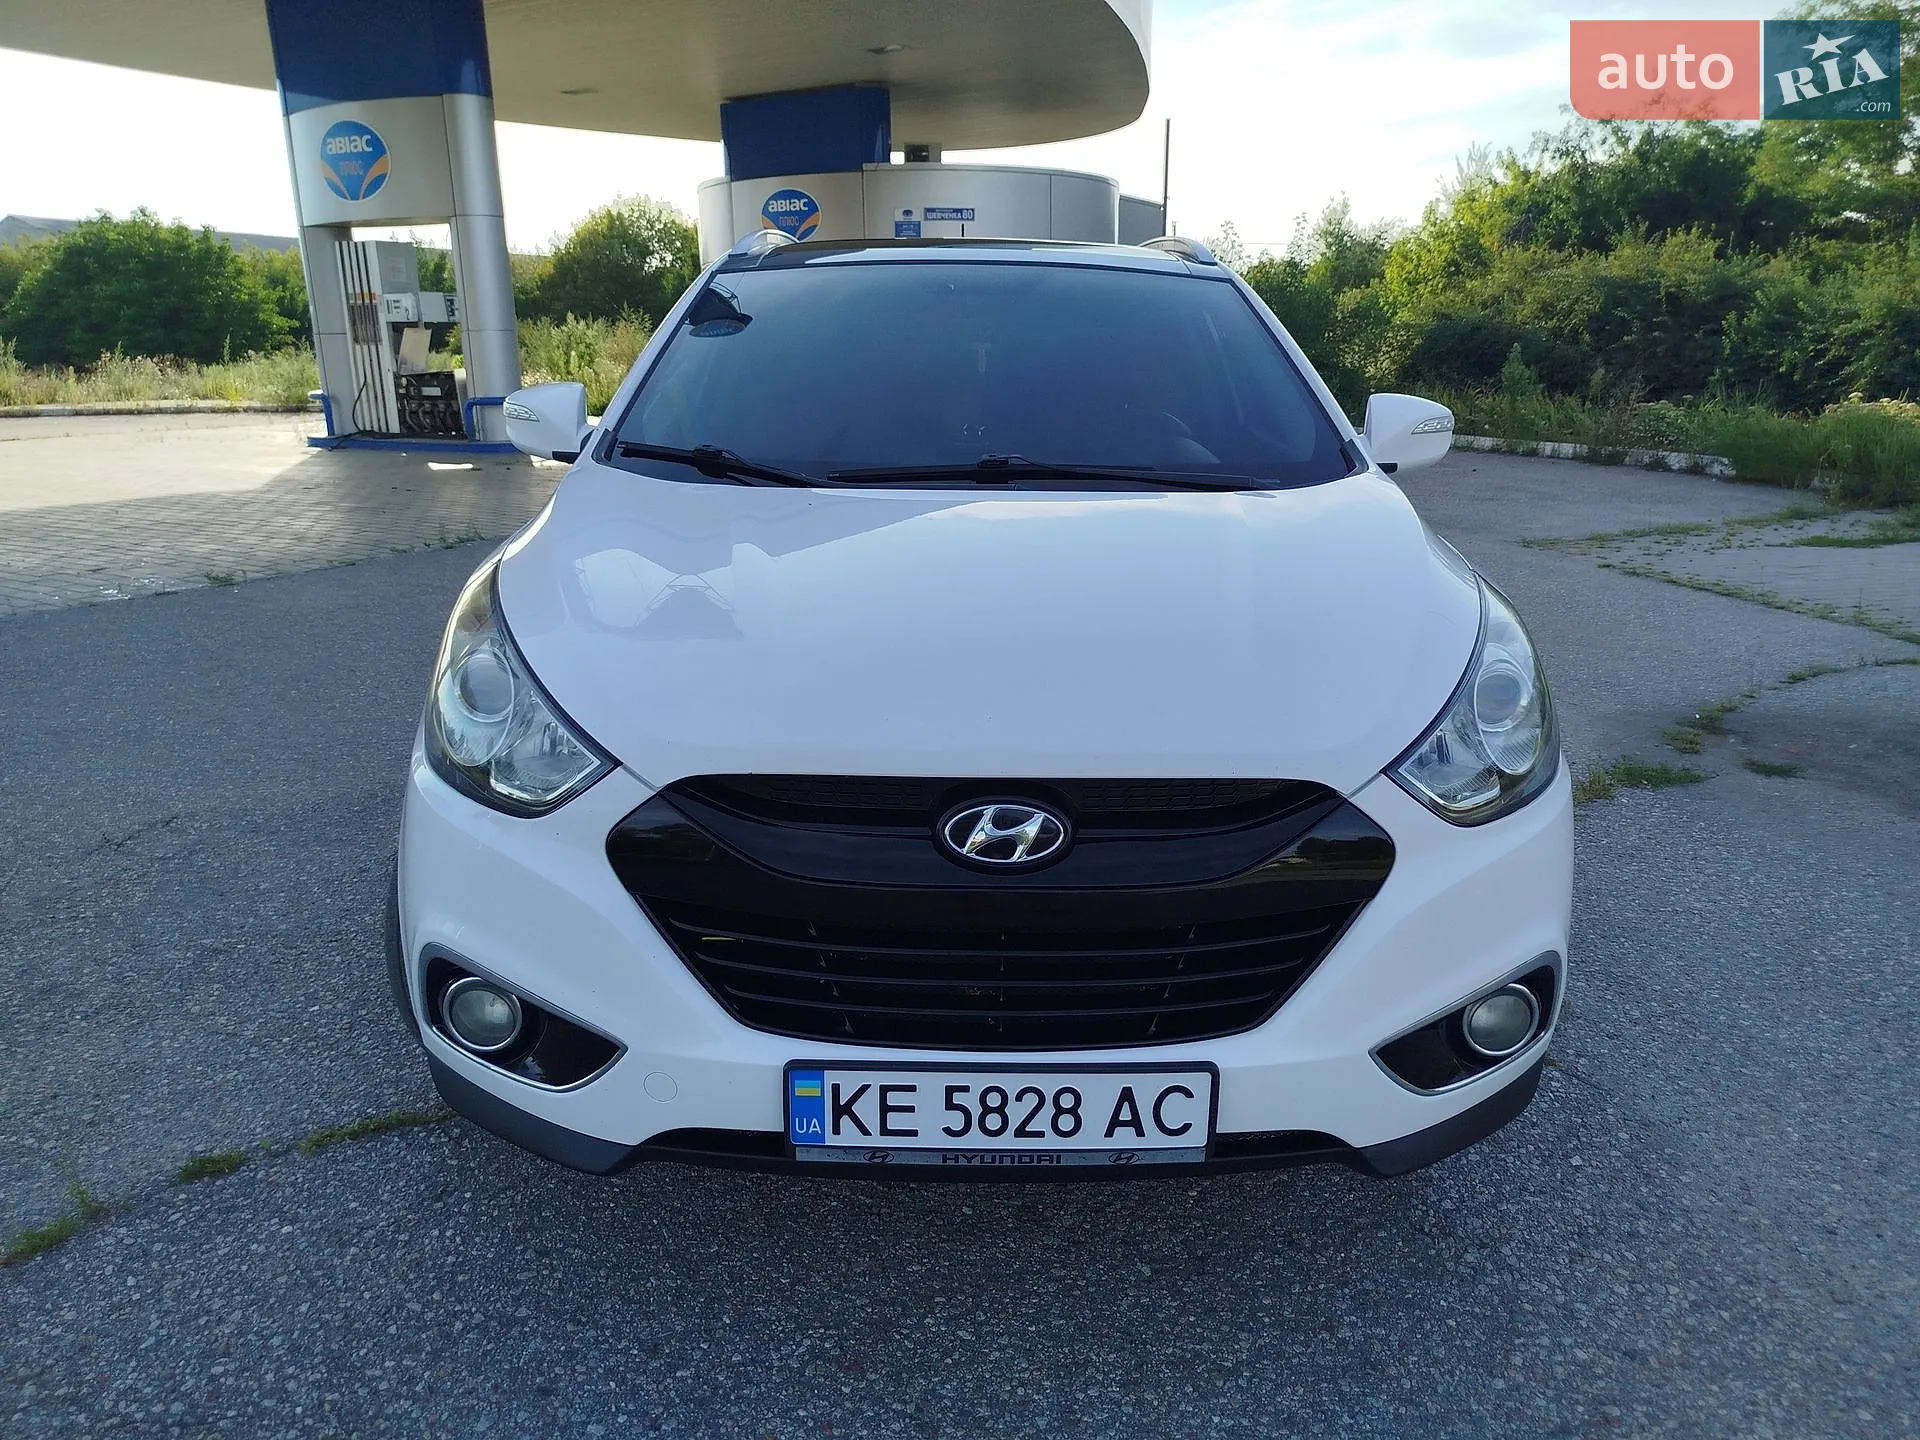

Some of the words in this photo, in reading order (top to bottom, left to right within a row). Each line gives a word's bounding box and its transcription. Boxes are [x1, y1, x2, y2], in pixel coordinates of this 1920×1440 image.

[831, 1083, 919, 1137] KE
[941, 1085, 1083, 1138] 5828
[1103, 1085, 1195, 1138] AC
[795, 1118, 821, 1134] UA
[941, 1153, 1062, 1165] HYUNDAI
